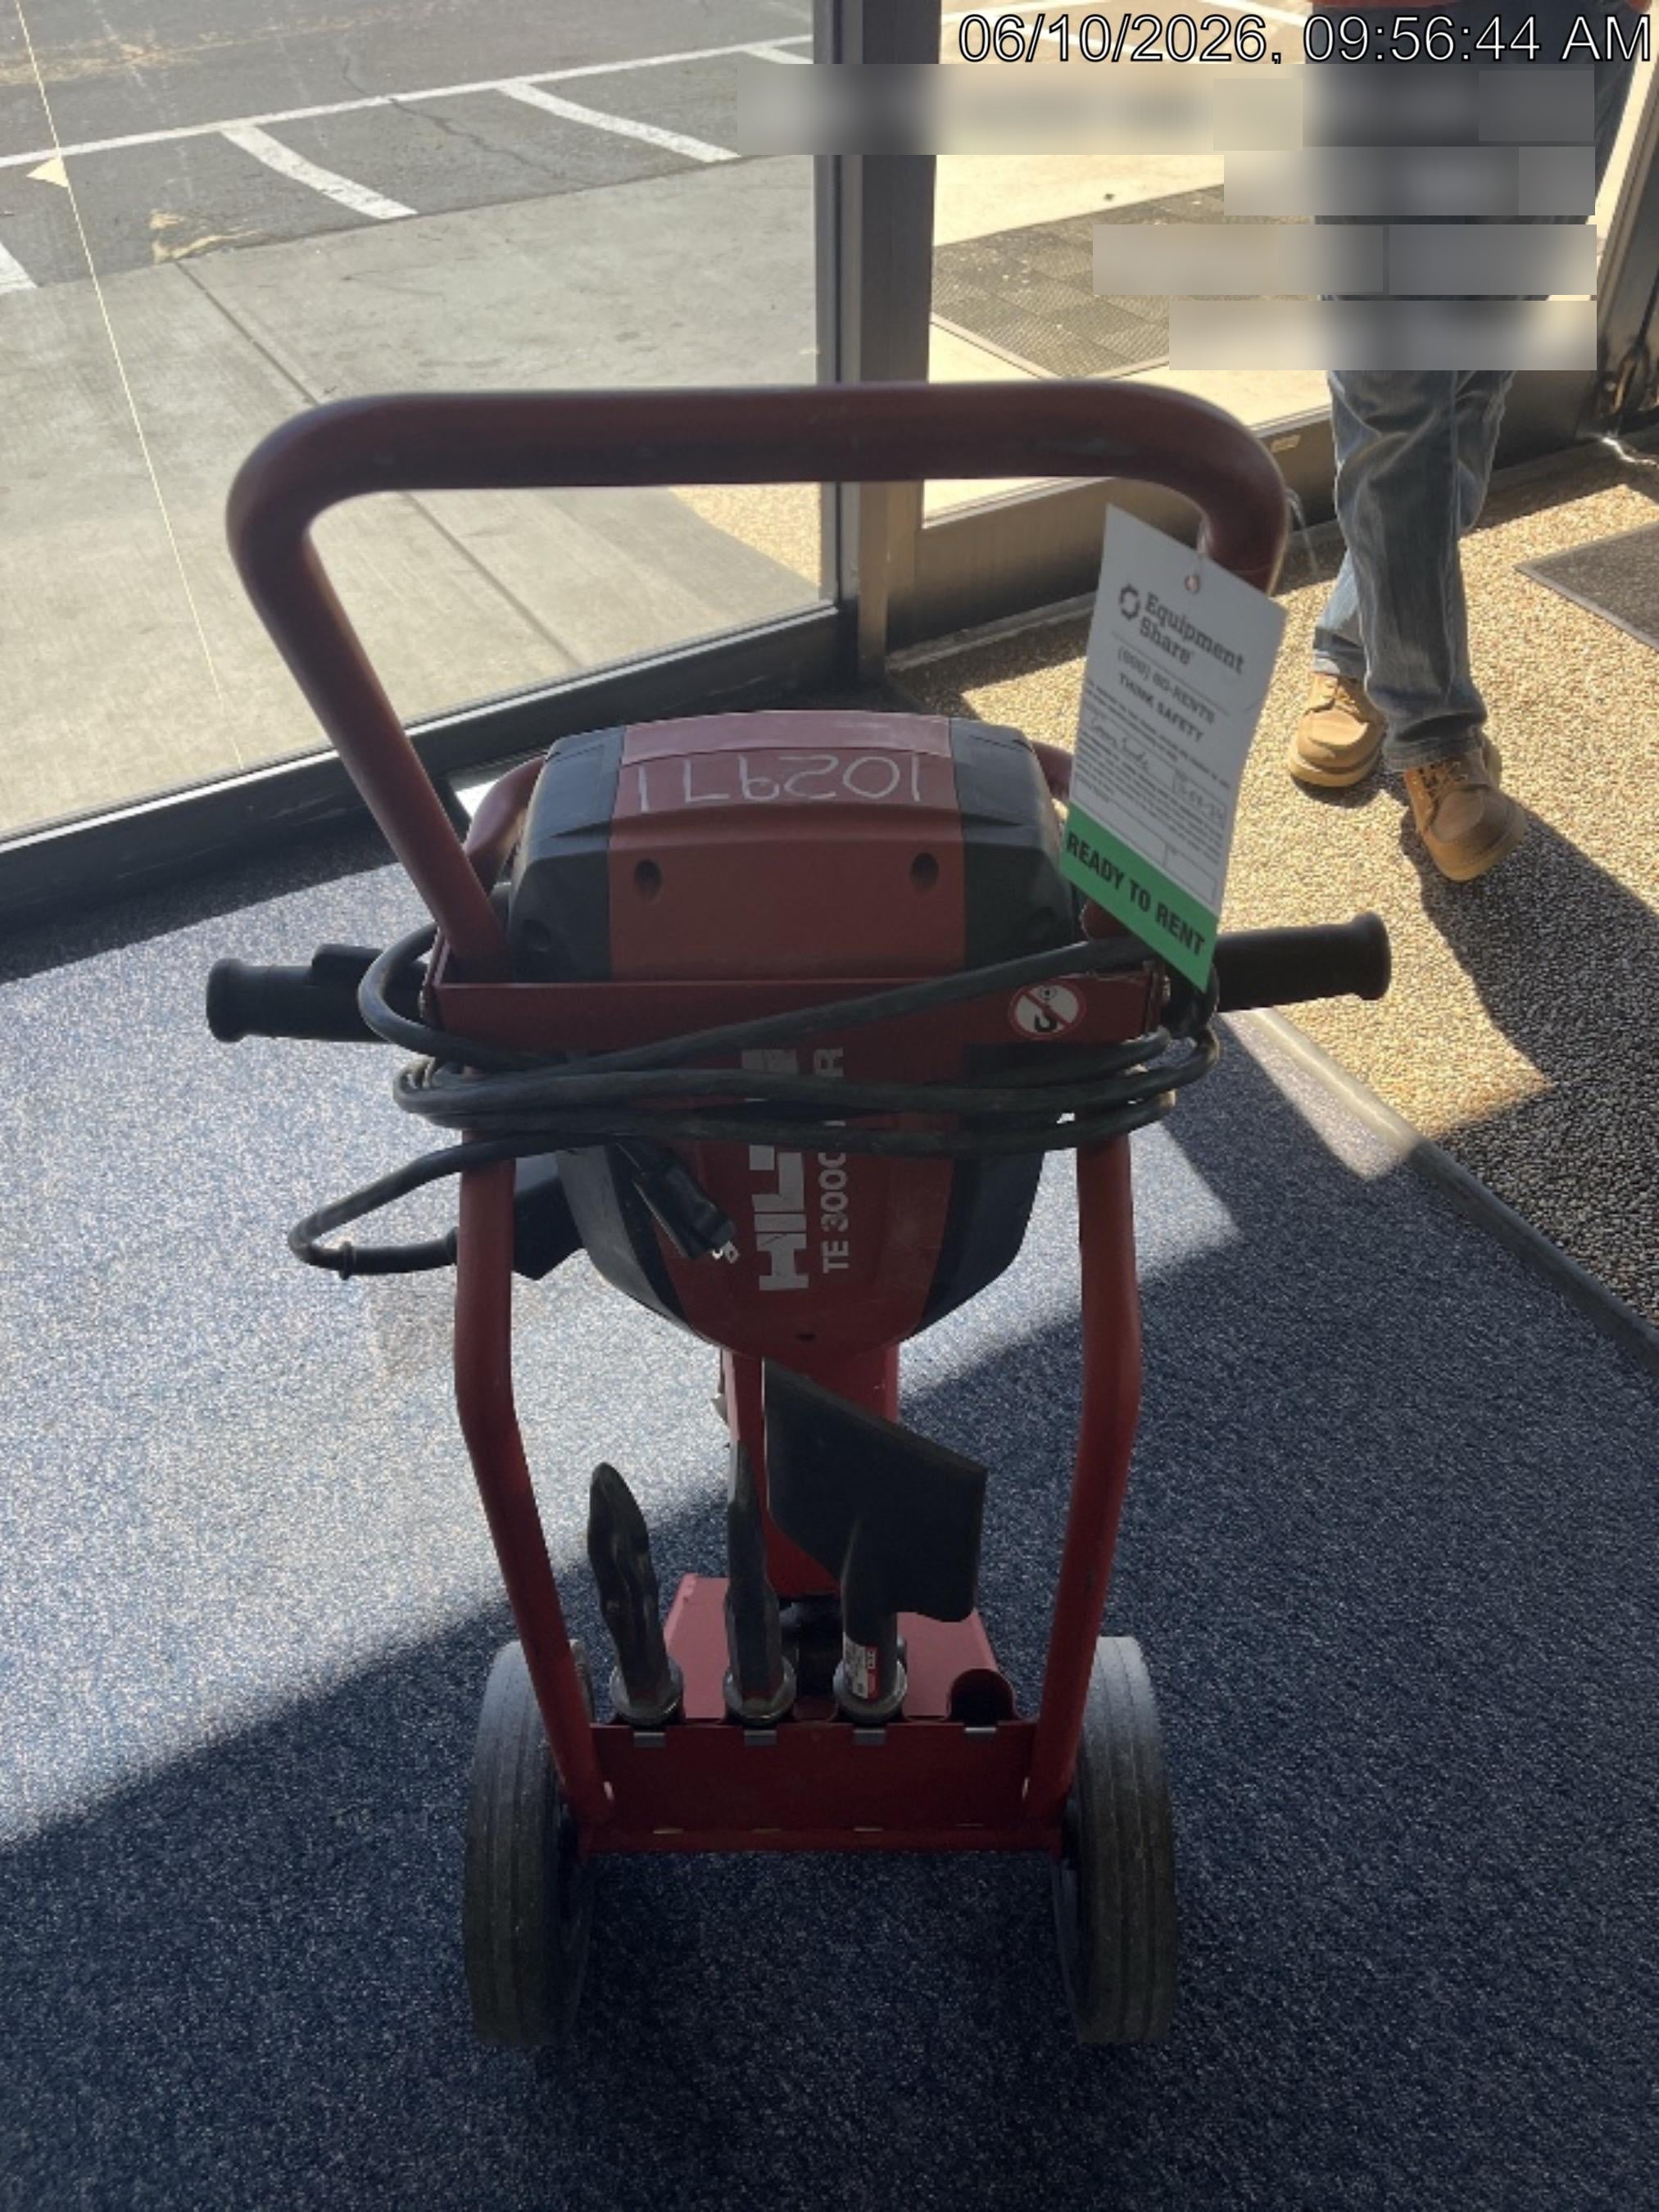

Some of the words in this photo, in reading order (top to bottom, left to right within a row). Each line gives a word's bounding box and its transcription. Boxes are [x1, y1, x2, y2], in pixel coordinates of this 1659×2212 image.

[1140, 616, 1191, 665] Share
[1145, 592, 1245, 674] Equipment
[1119, 672, 1154, 709] THINK
[1156, 700, 1204, 742] SAFETY
[637, 751, 921, 814] 102971
[1066, 832, 1125, 891] READY
[1128, 878, 1151, 913] TO
[1155, 902, 1206, 956] RENT
[822, 1240, 850, 1274] TE
